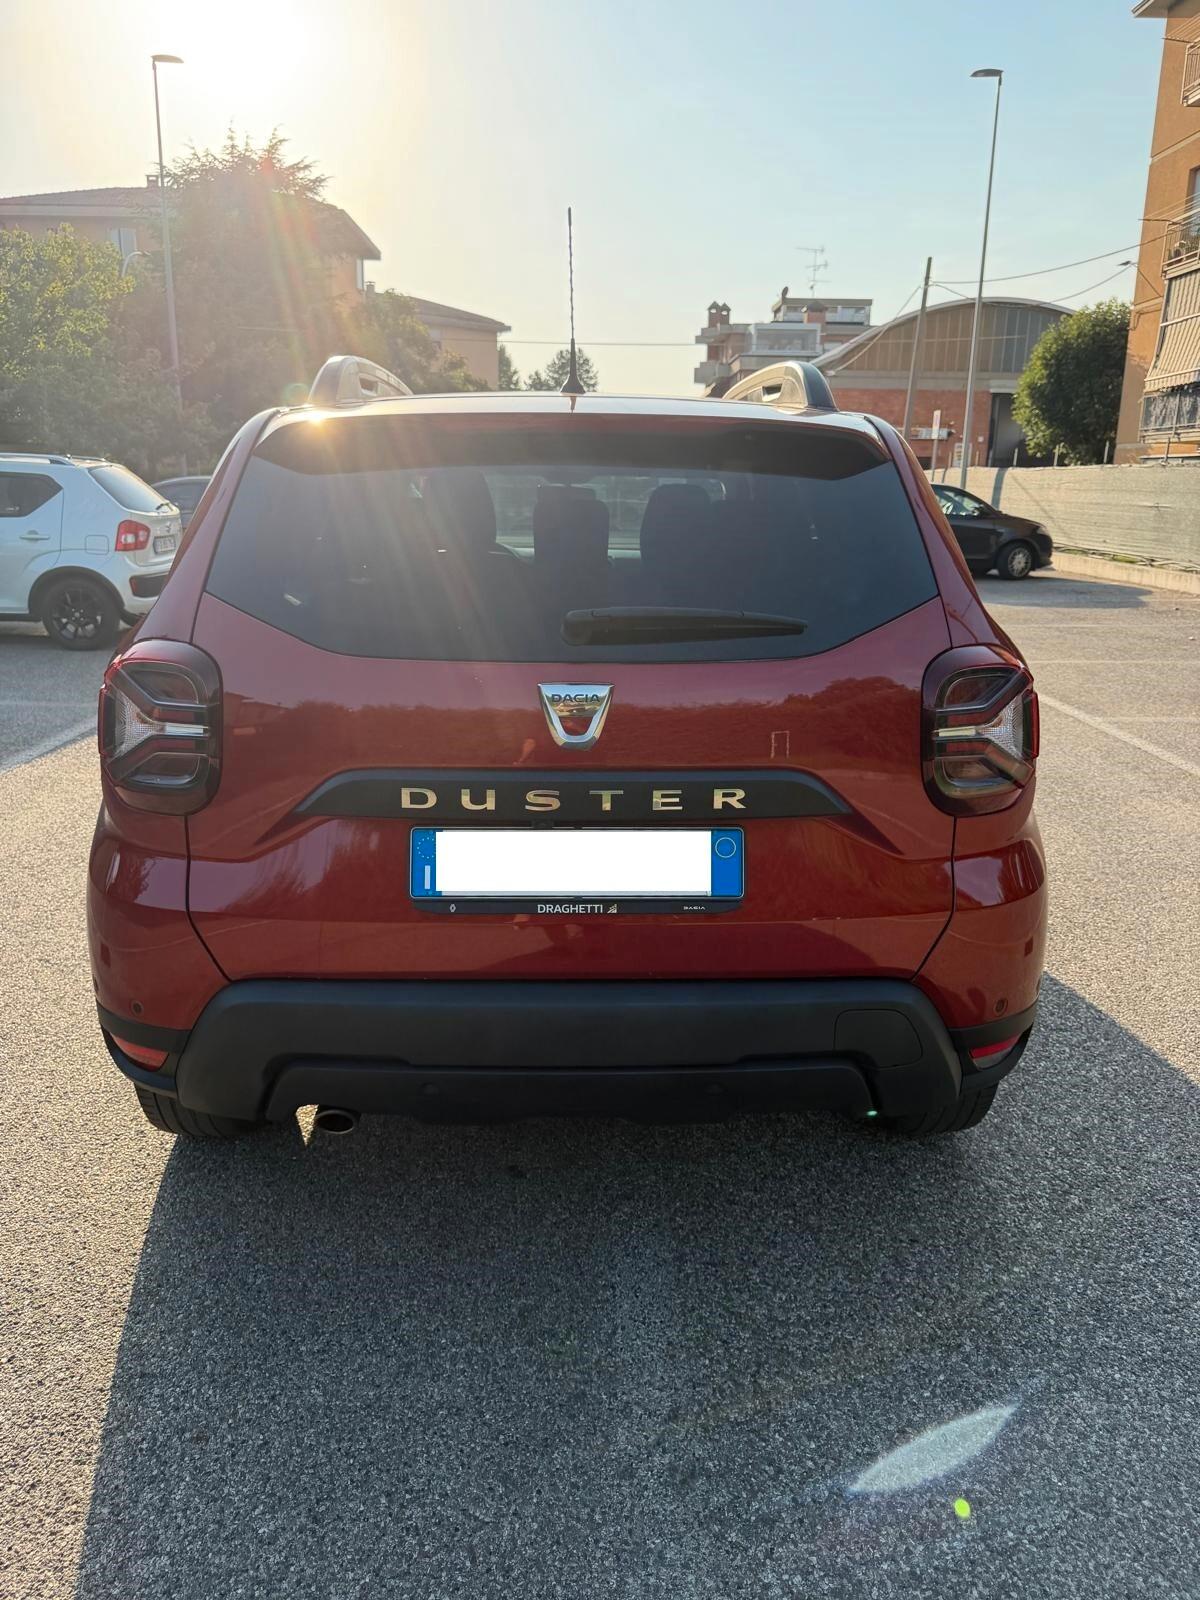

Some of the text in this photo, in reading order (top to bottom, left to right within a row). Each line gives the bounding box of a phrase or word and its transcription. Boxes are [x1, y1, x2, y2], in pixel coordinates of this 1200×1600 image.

[551, 694, 601, 703] DACIA
[400, 787, 747, 811] DUSTER
[537, 904, 603, 914] DRAGHETTI
